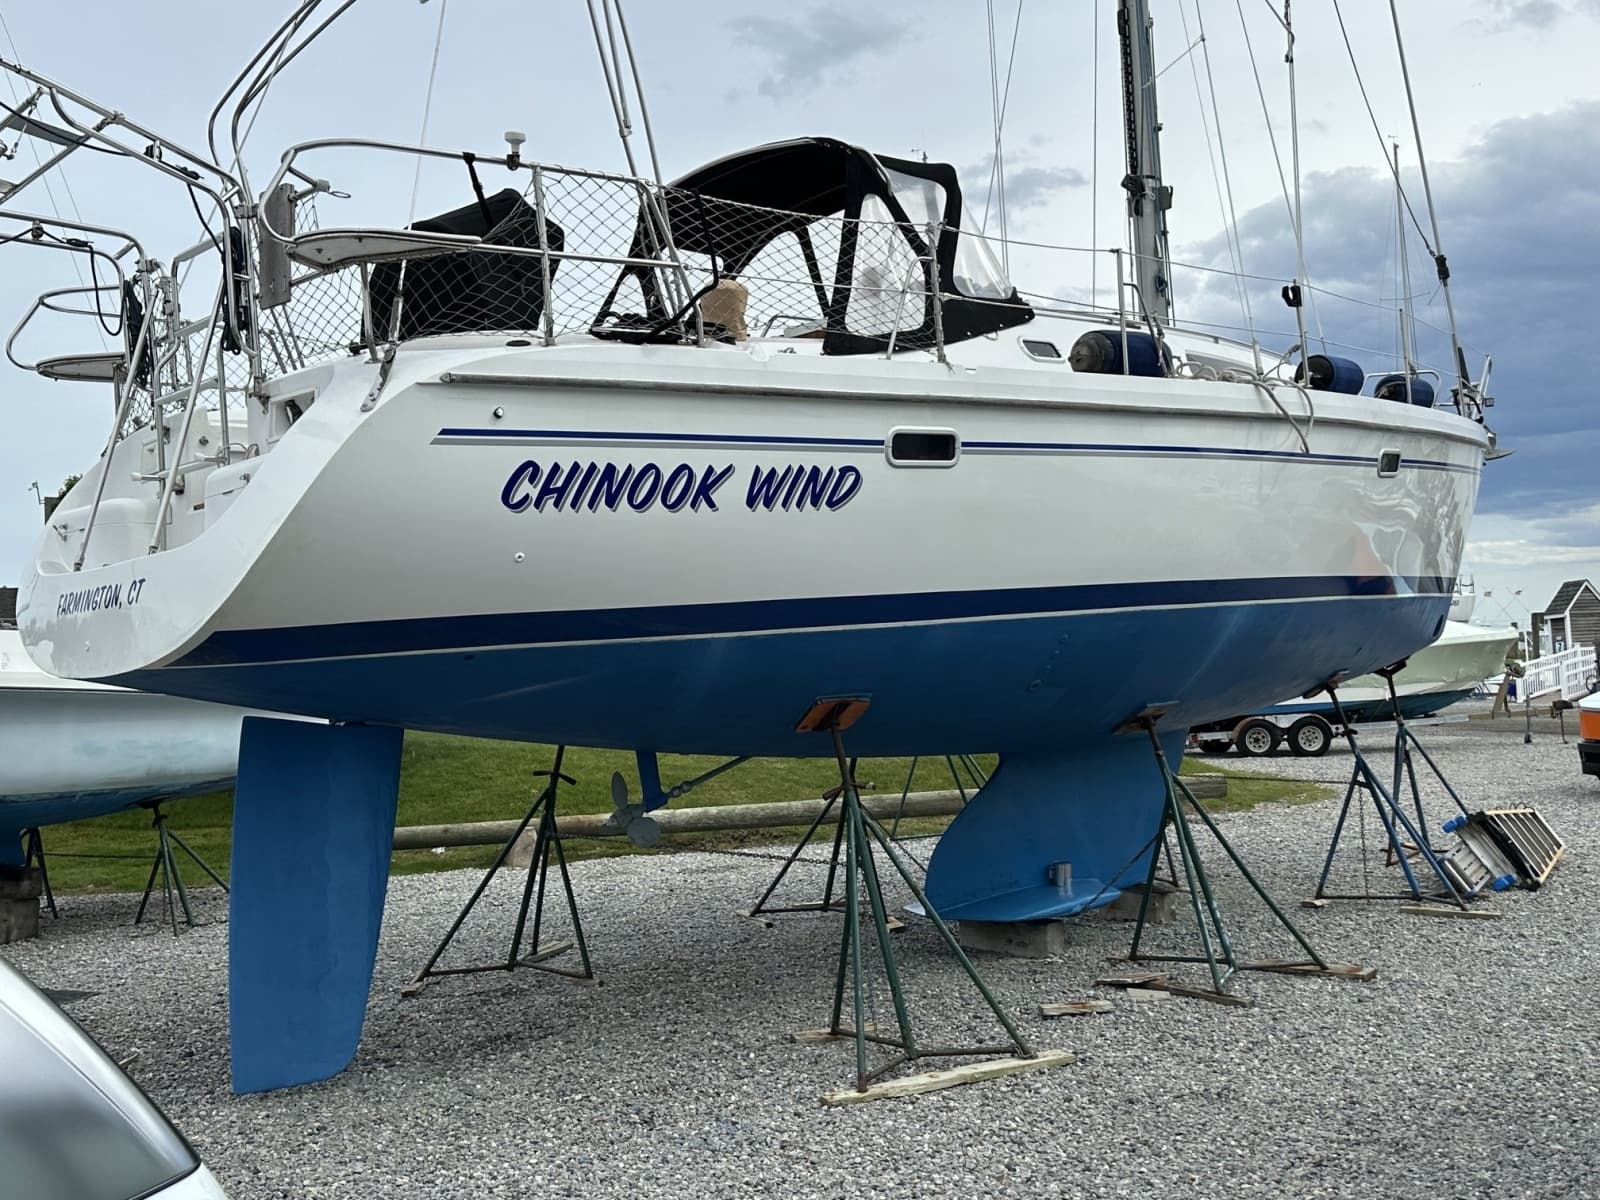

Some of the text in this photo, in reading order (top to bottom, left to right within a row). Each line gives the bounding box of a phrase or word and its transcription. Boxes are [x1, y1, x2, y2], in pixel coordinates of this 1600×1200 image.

[500, 459, 863, 513] CHINOOK WIND
[57, 578, 146, 617] FARMINGTON, CT
